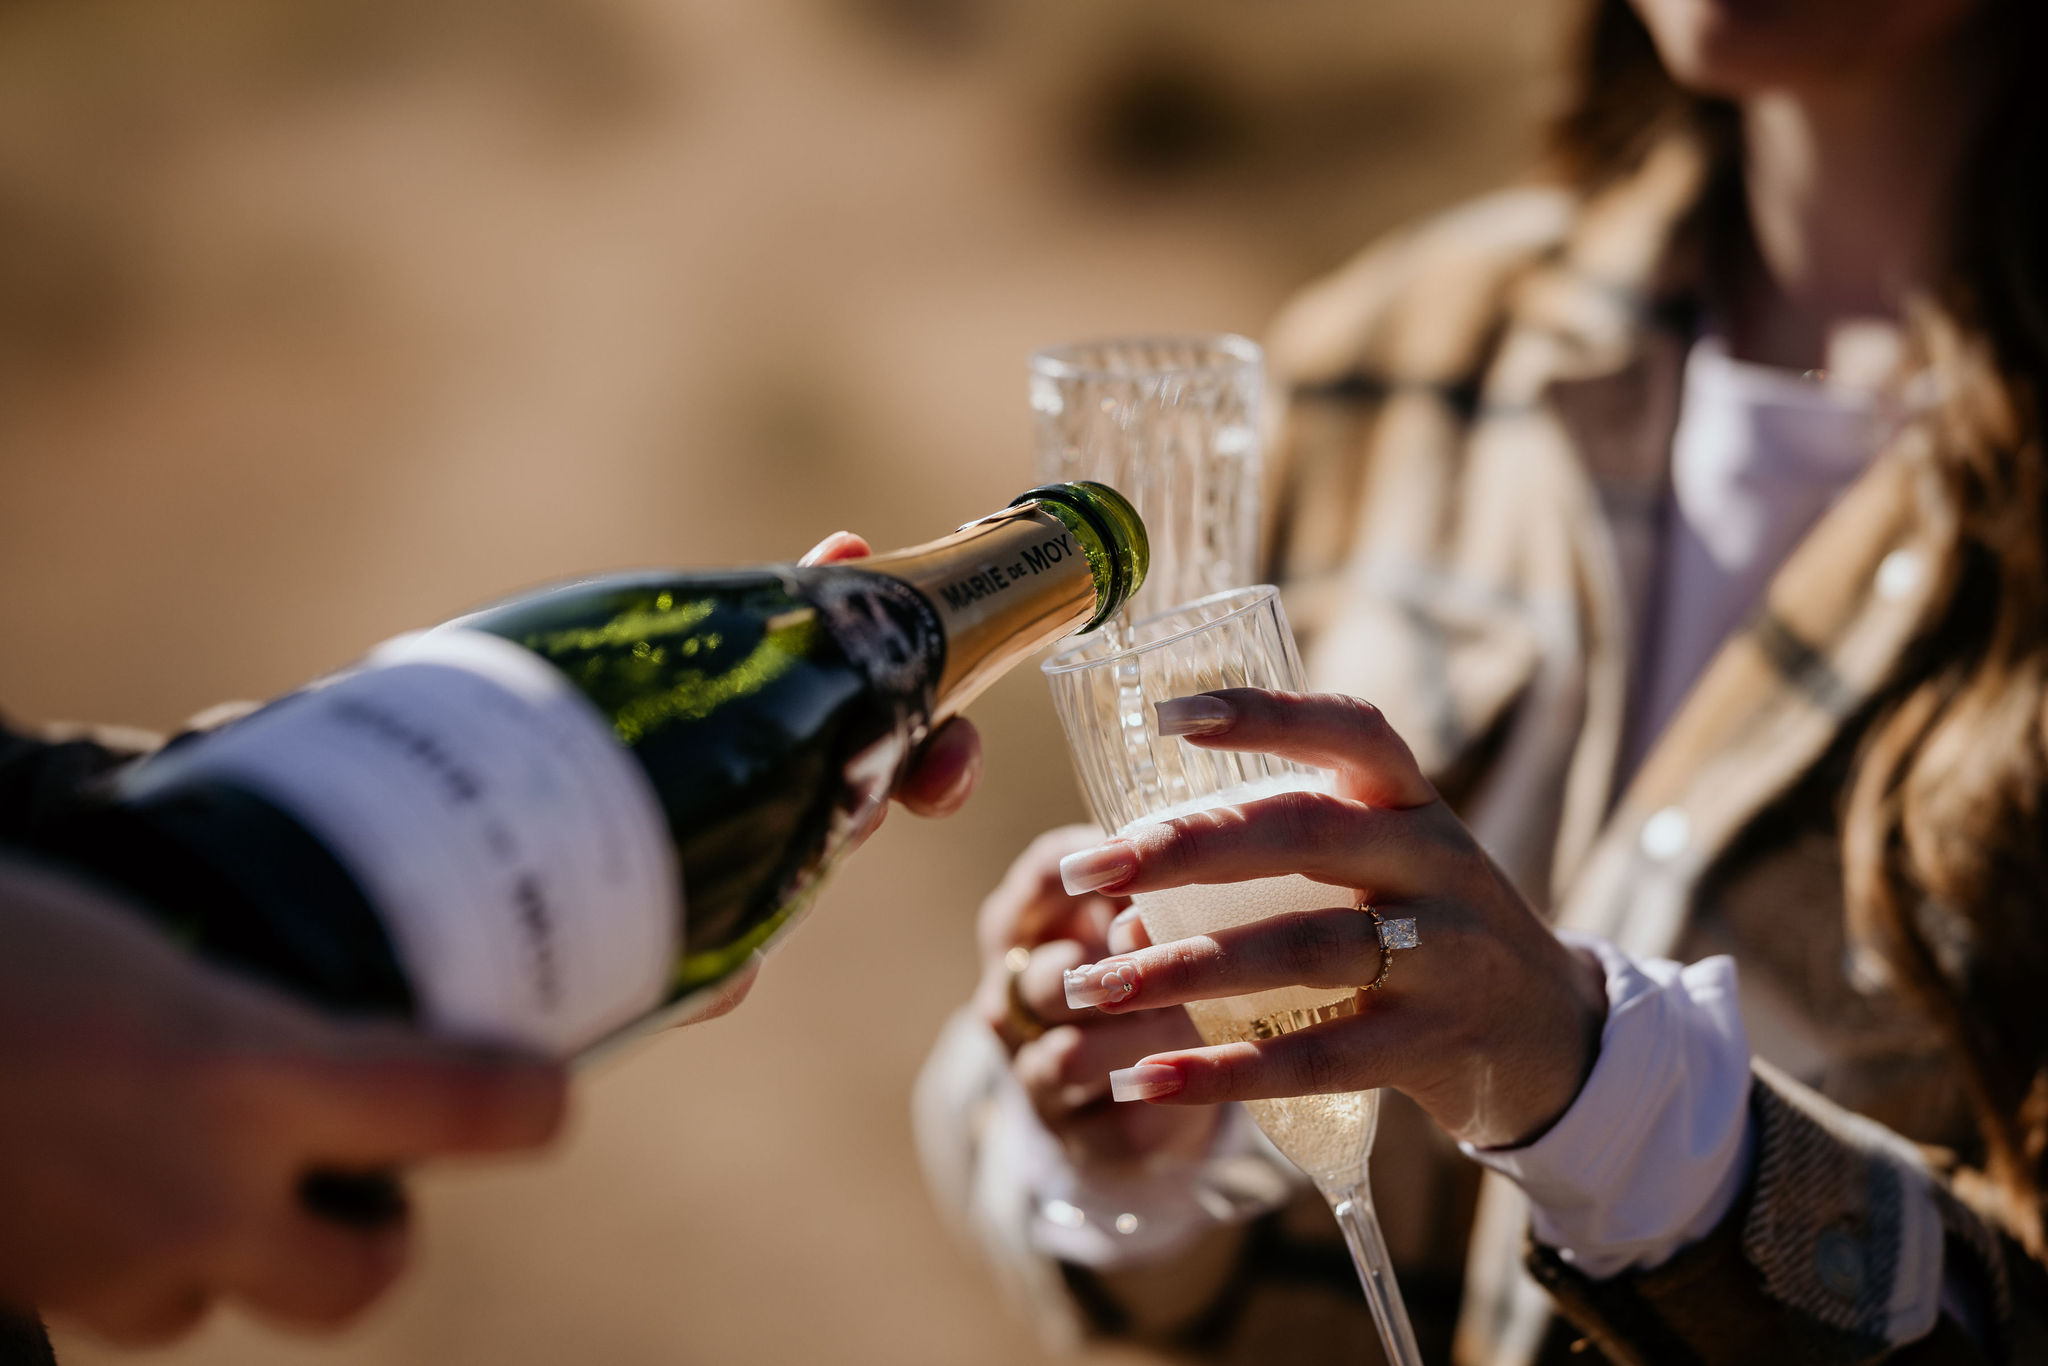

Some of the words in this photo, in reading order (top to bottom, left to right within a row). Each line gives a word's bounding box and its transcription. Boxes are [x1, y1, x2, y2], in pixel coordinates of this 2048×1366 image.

[940, 567, 1010, 611] MARIE
[1008, 562, 1027, 580] DE
[1021, 534, 1073, 575] MOY
